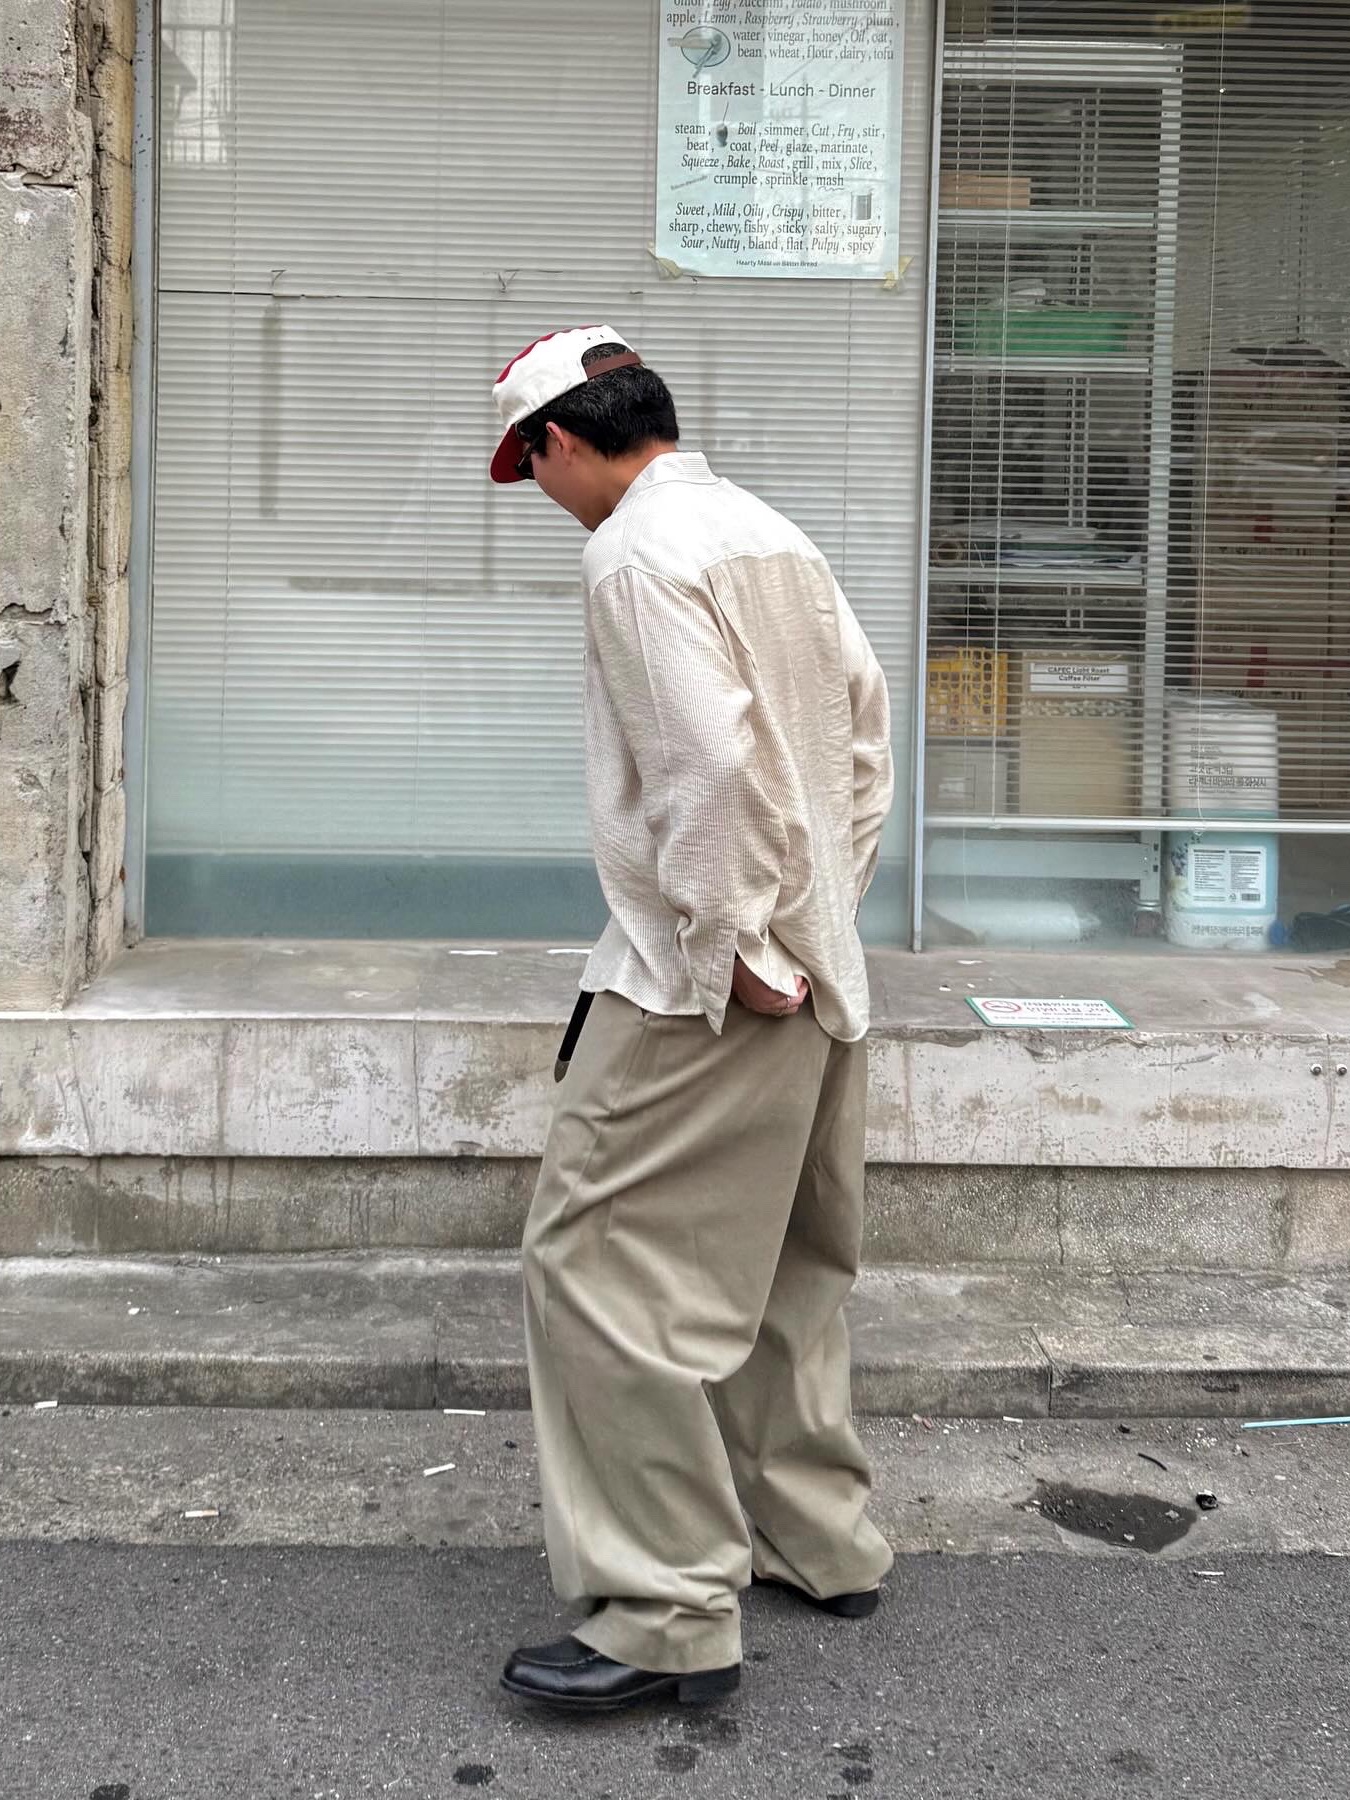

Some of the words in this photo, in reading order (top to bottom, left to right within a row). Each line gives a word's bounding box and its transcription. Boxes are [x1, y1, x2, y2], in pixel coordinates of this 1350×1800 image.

[666, 9, 695, 27] apple
[703, 10, 736, 24] Lemon
[745, 11, 794, 29] Raspberry
[802, 12, 858, 29] Strawberry
[866, 13, 894, 30] plum
[733, 31, 760, 41] water
[768, 28, 805, 45] vinegar
[812, 28, 843, 45] honey
[850, 29, 865, 43] Oil
[738, 44, 762, 58] bean
[769, 44, 800, 58] wheat
[807, 45, 833, 59] flour
[840, 46, 866, 63] dairy
[874, 46, 894, 60] tofu
[687, 81, 755, 96] Breakfast
[770, 83, 814, 97] Lunch
[829, 84, 876, 98] Dinner
[675, 124, 706, 134] steam
[738, 122, 756, 135] Boil
[764, 123, 804, 136] simmer
[812, 123, 829, 136] Cut
[837, 124, 855, 140] Fry
[862, 124, 880, 137] stir
[686, 137, 708, 151] beat
[730, 139, 751, 152] coat
[760, 139, 778, 152] Peel
[786, 139, 813, 156] glaze
[820, 140, 868, 153] marinate
[681, 154, 719, 170] Squeeze
[727, 155, 751, 168] Bake
[758, 156, 784, 169] Roast
[792, 156, 814, 173] grill
[822, 157, 842, 170] mix
[849, 157, 872, 170] Slice
[714, 171, 758, 188] crumple
[765, 172, 808, 189] sprinkle
[816, 173, 844, 186] mash
[676, 202, 704, 216] Sweet
[713, 203, 736, 216] Mild
[743, 204, 764, 220] Oily
[772, 204, 804, 221] Crispy
[812, 205, 841, 218] bitter
[669, 218, 699, 236] sharp
[744, 220, 769, 237] fishy
[777, 221, 807, 237] sticky
[815, 221, 839, 238] salty
[847, 224, 882, 239] sugary
[680, 236, 704, 249] Sour
[711, 236, 740, 253] Nutty
[748, 236, 778, 250] bland
[786, 236, 803, 250] flat
[812, 238, 839, 254] Pulpy
[847, 239, 874, 255] spicy
